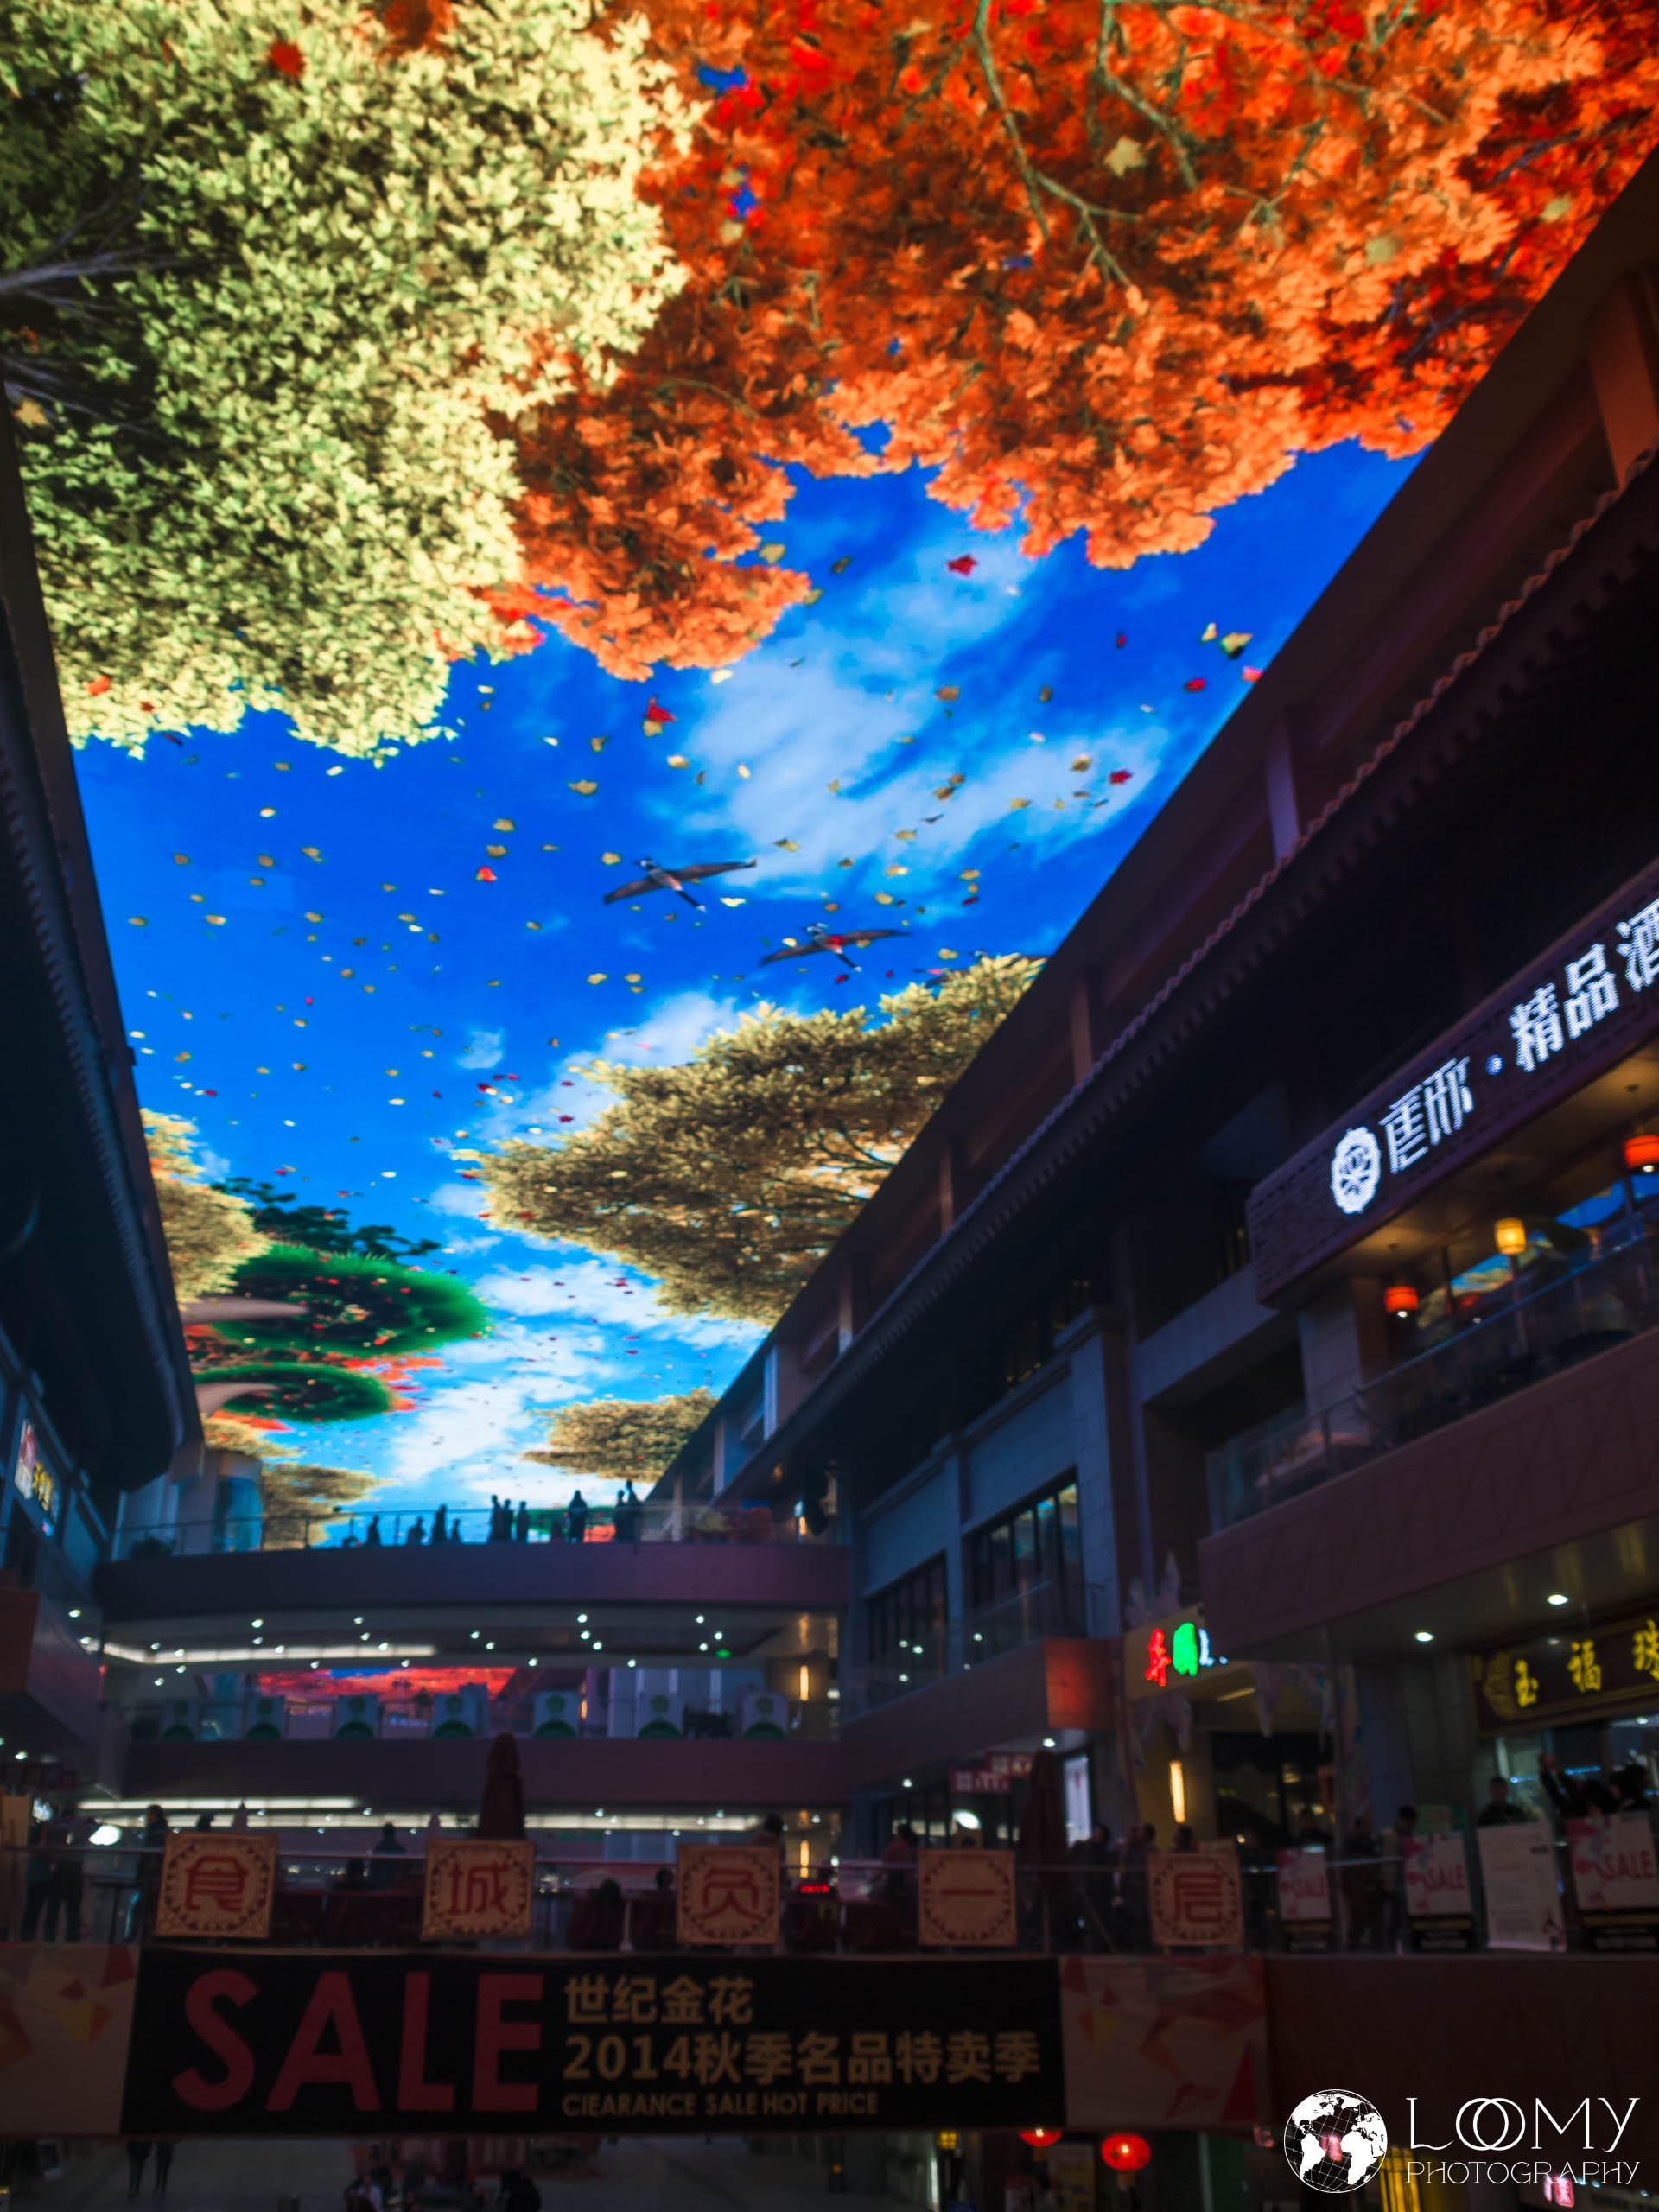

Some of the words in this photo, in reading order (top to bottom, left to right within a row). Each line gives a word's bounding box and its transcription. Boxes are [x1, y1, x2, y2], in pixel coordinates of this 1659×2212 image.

[1601, 1850, 1654, 1880] SALE
[563, 1974, 754, 2025] 世纪金花
[171, 1969, 543, 2112] SALE
[562, 2031, 1042, 2086] 2014秋季名品特卖季
[705, 2093, 757, 2117] SALE
[762, 2093, 808, 2116] HOT
[816, 2091, 880, 2116] PRICE
